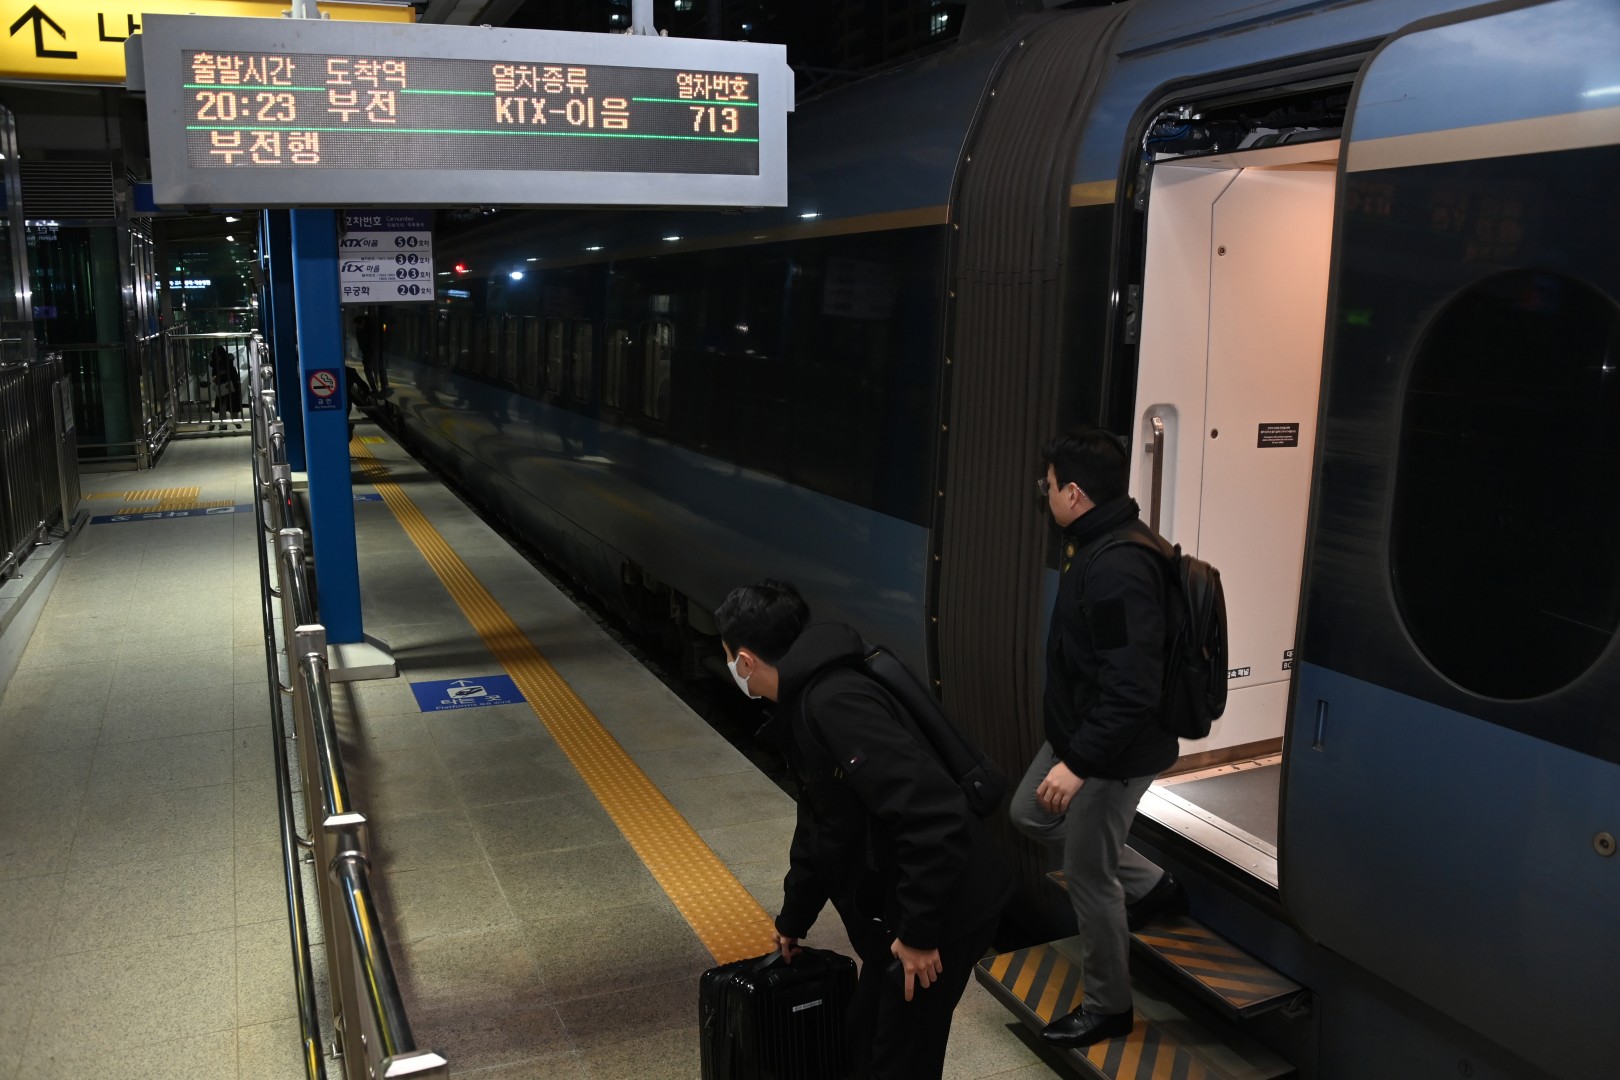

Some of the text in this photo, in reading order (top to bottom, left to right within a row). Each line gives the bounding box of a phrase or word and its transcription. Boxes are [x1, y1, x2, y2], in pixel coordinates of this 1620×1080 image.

[192, 51, 749, 101] 출발시간 도착역 열차종류 열차번호
[195, 90, 739, 133] 20:23 부전 KTX-이음 713
[209, 130, 320, 164] 부전행
[343, 286, 370, 296] 무궁화
